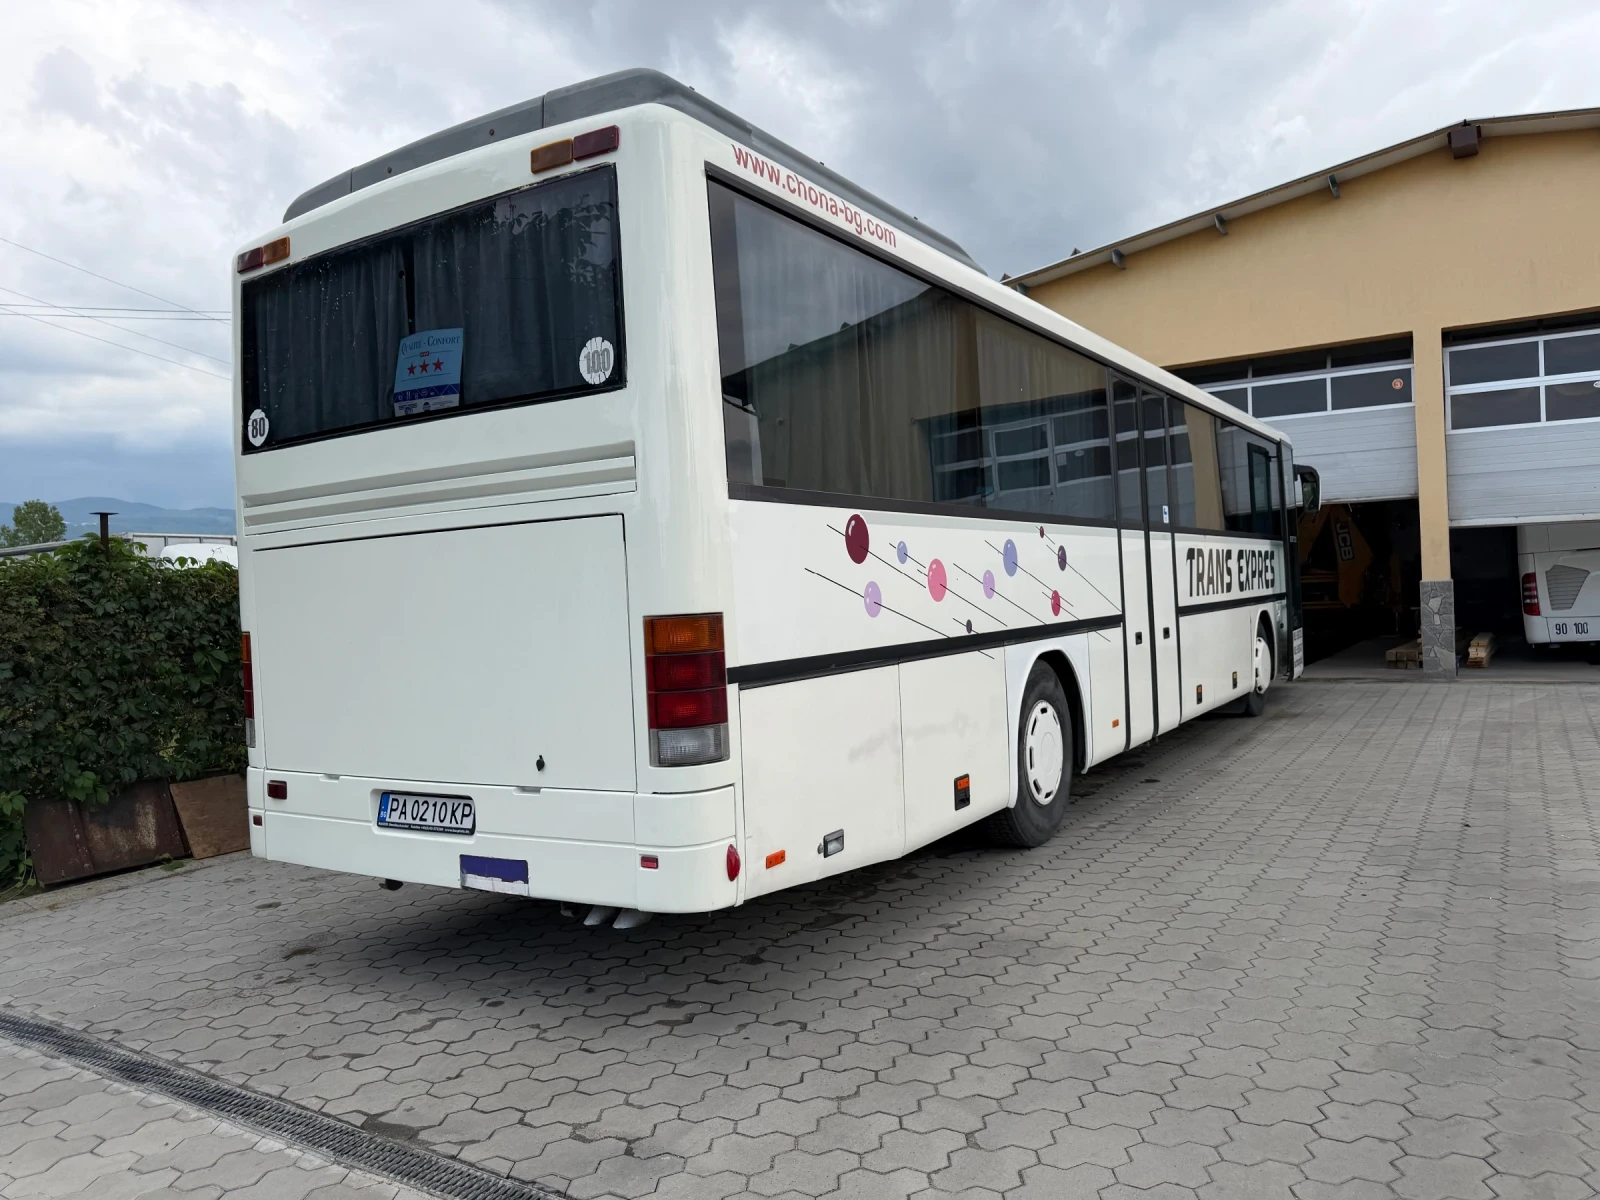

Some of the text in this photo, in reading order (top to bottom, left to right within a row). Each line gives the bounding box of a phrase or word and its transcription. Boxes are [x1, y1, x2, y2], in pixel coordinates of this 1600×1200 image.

[731, 144, 897, 248] www.chona-bg.com
[584, 348, 610, 374] 100
[251, 417, 265, 438] 80
[1336, 522, 1354, 560] JCB
[1186, 547, 1275, 597] TRANS EXPRES
[1555, 622, 1589, 635] 90 100
